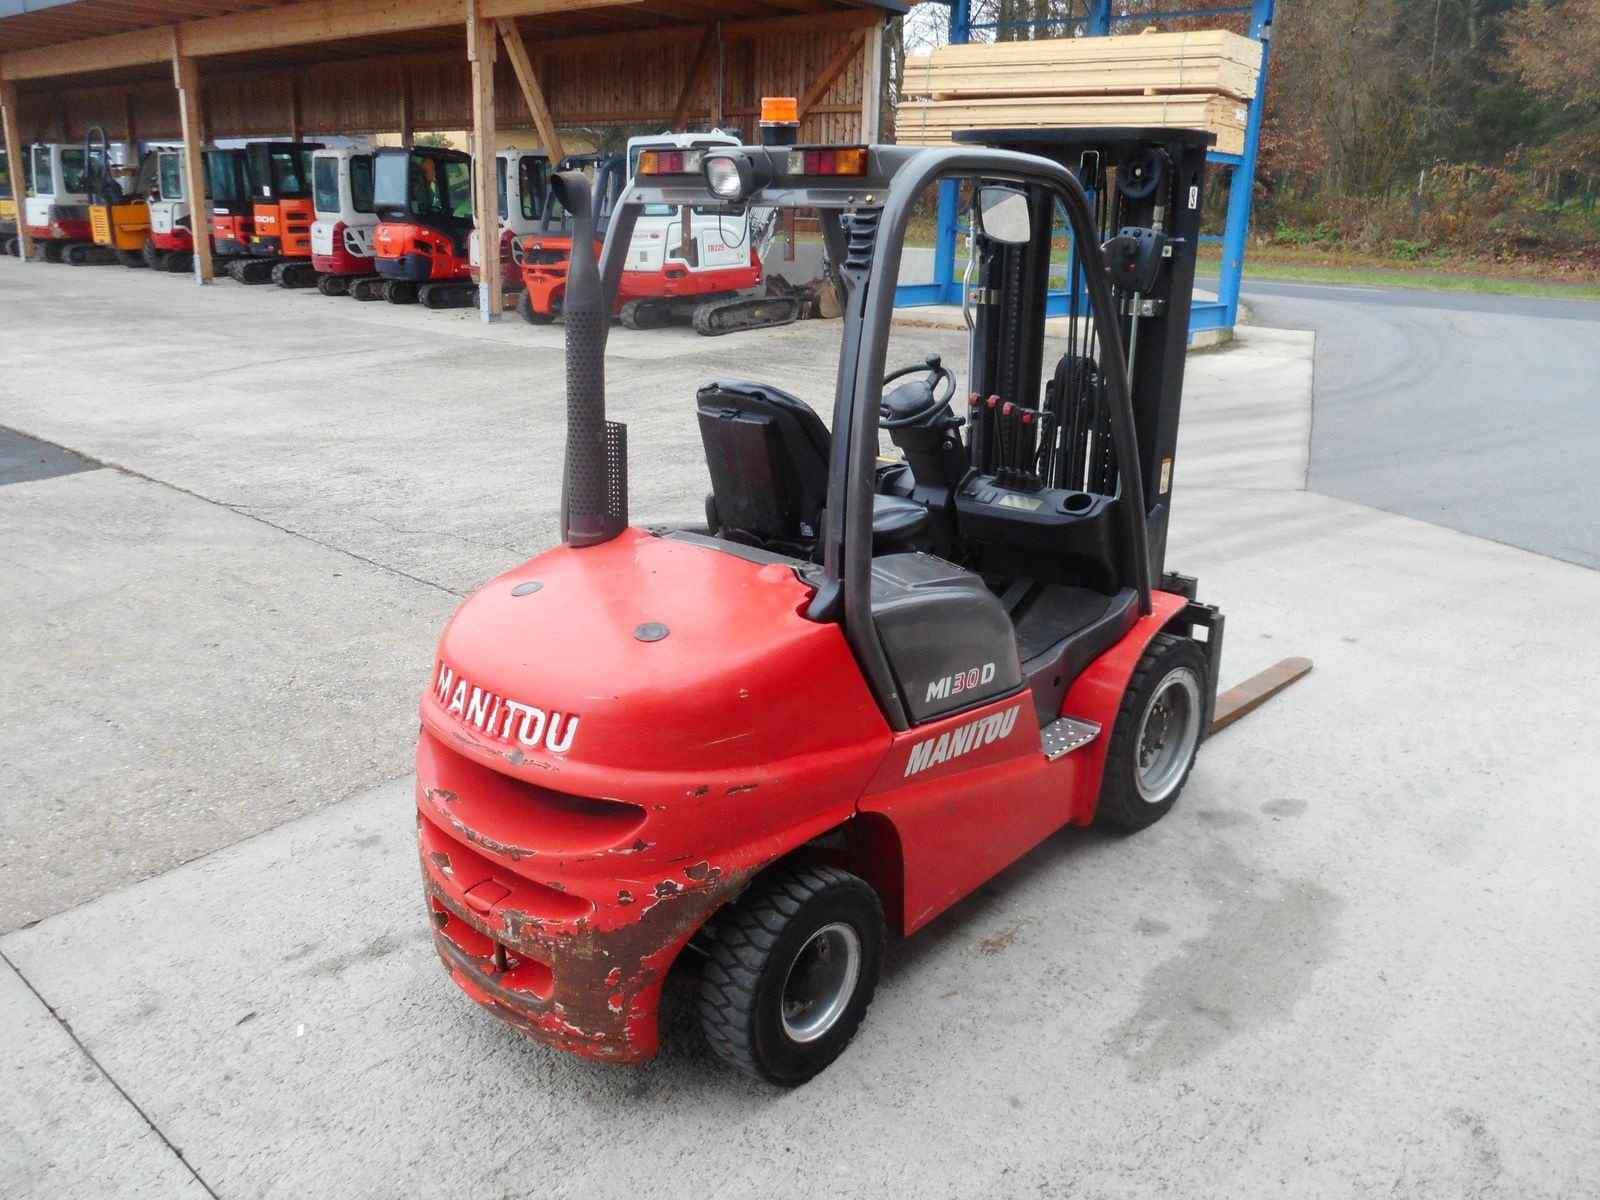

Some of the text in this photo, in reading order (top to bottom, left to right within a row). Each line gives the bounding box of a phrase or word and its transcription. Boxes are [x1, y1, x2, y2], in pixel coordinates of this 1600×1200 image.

[707, 244, 725, 253] TB225
[434, 660, 580, 753] MANITOU
[925, 662, 996, 702] MI30D
[903, 704, 1021, 778] MANITOU
